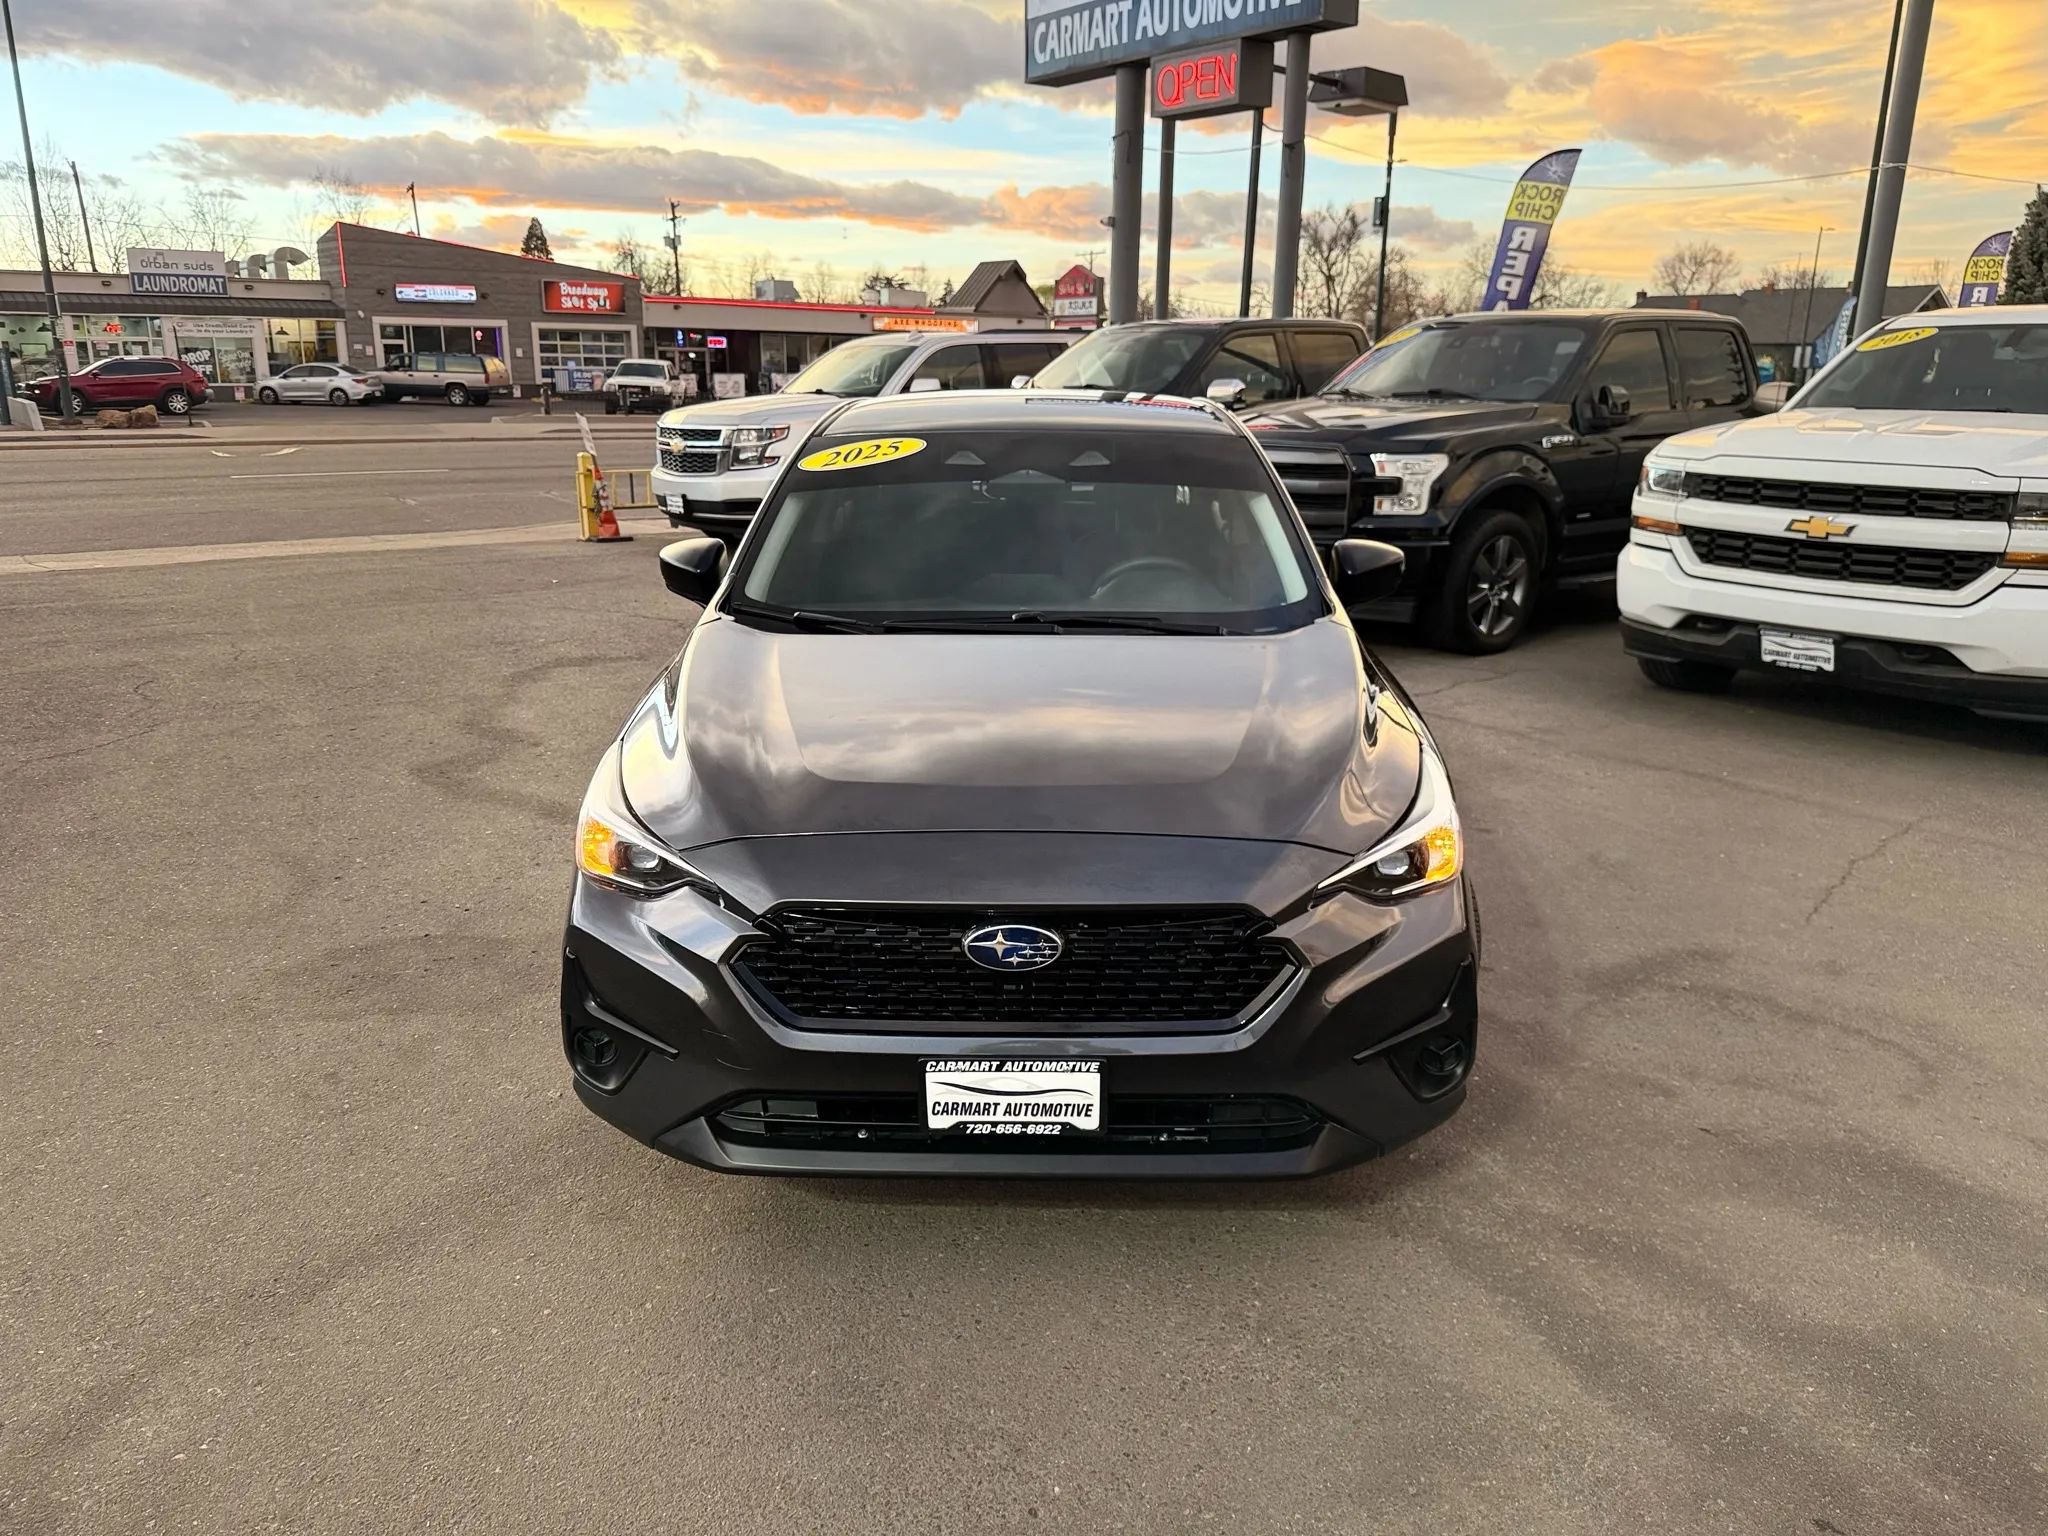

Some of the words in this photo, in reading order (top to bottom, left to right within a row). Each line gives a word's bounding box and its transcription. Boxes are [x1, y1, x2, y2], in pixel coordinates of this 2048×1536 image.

[1032, 4, 1131, 63] CARMART
[1134, 0, 1302, 41] AUTOMO
[1156, 52, 1238, 108] OPEN
[140, 256, 179, 270] urban
[183, 261, 215, 272] suds
[133, 274, 225, 294] LAUNDROMAT
[181, 350, 211, 364] DROP
[821, 440, 904, 468] 2025
[926, 1061, 1000, 1073] CARMART
[1002, 1061, 1101, 1073] AUTOMOTIVE
[931, 1101, 1001, 1117] CARMART
[1003, 1102, 1094, 1118] AUTOMOTIVE
[965, 1124, 1062, 1136] 720-656-6922
